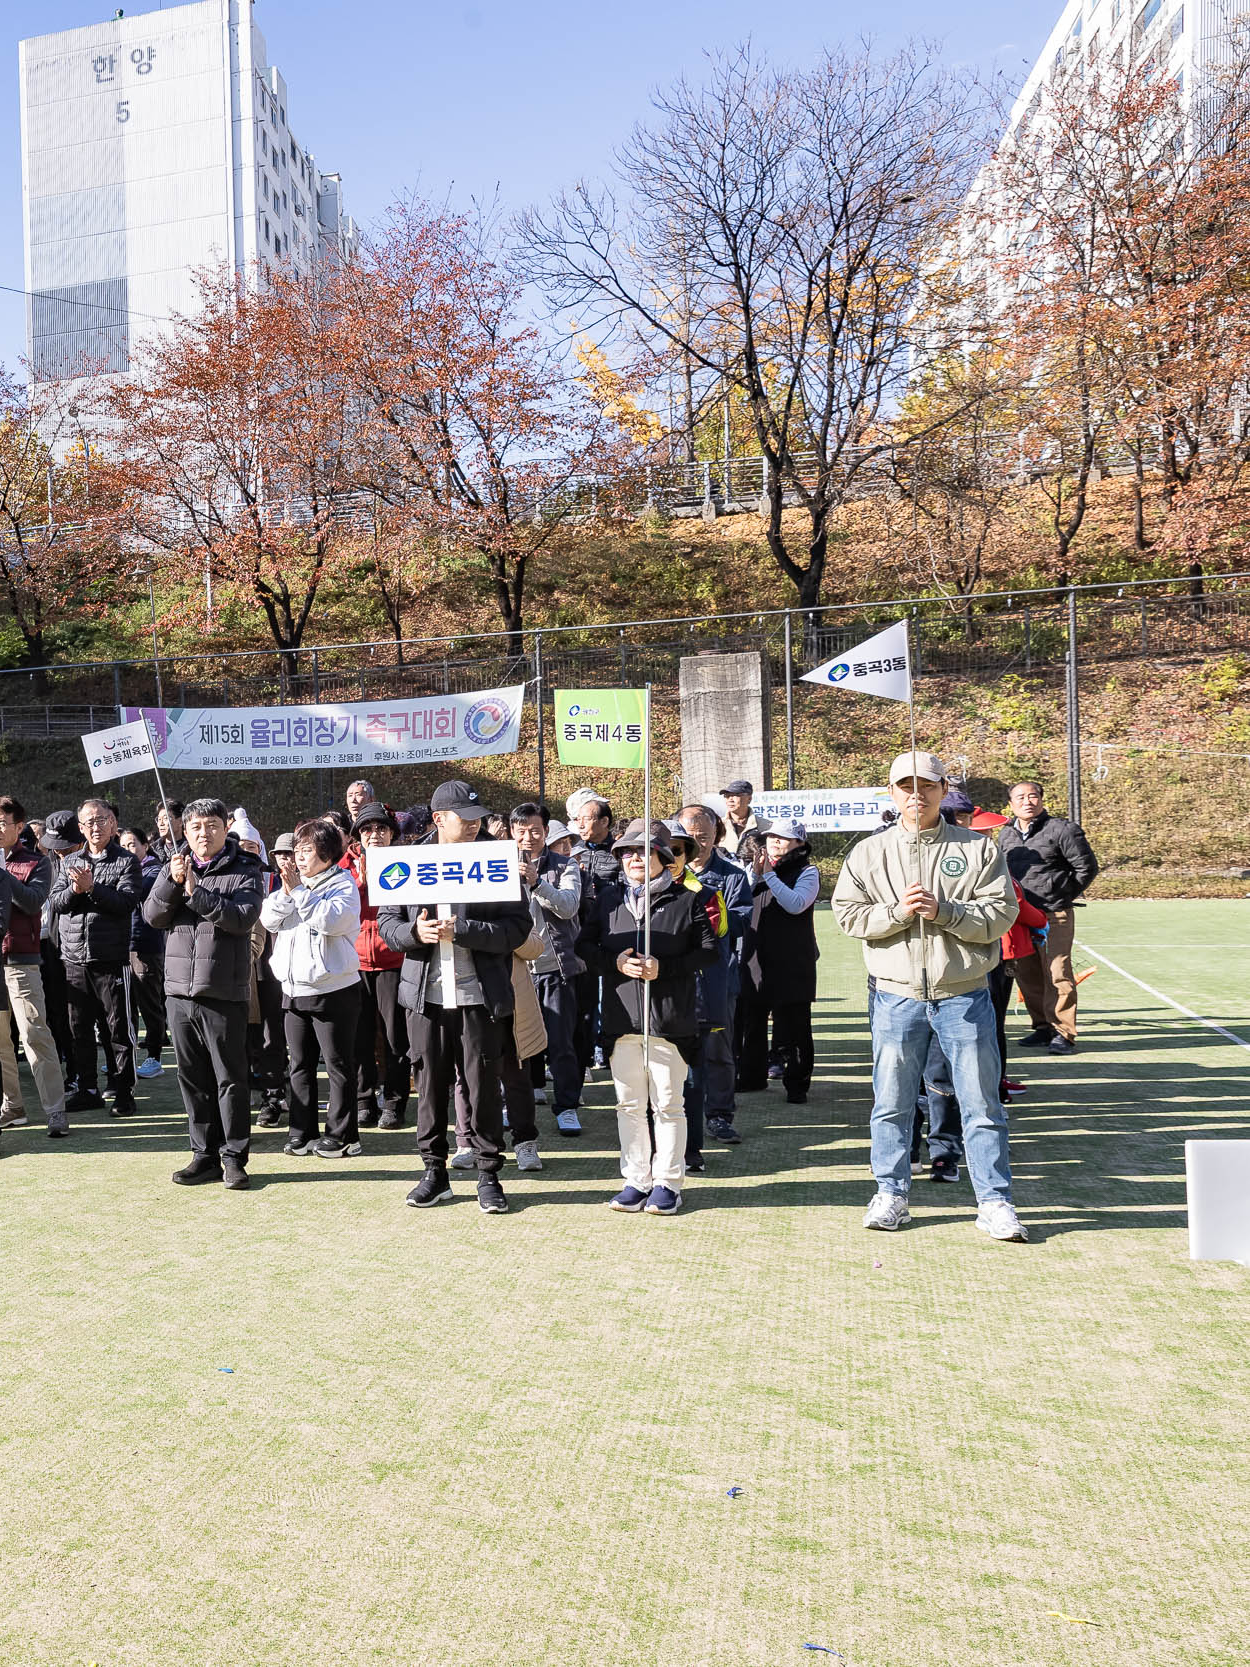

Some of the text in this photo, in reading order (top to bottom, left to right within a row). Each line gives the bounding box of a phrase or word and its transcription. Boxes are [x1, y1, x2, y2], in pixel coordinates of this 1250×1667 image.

[116, 100, 130, 123] 5
[852, 656, 907, 677] 중곡3동
[199, 724, 245, 745] 제15회
[250, 714, 358, 749] 율리회장기
[365, 706, 457, 744] 족구대회
[563, 723, 642, 742] 중곡제4동
[102, 743, 151, 765] 능동체육회
[224, 756, 253, 765] 2025년
[254, 755, 268, 765] 4월
[269, 755, 304, 765] 26일(토)
[752, 802, 880, 819] 광진중앙 새마을금고
[416, 859, 510, 886] 중곡4동
